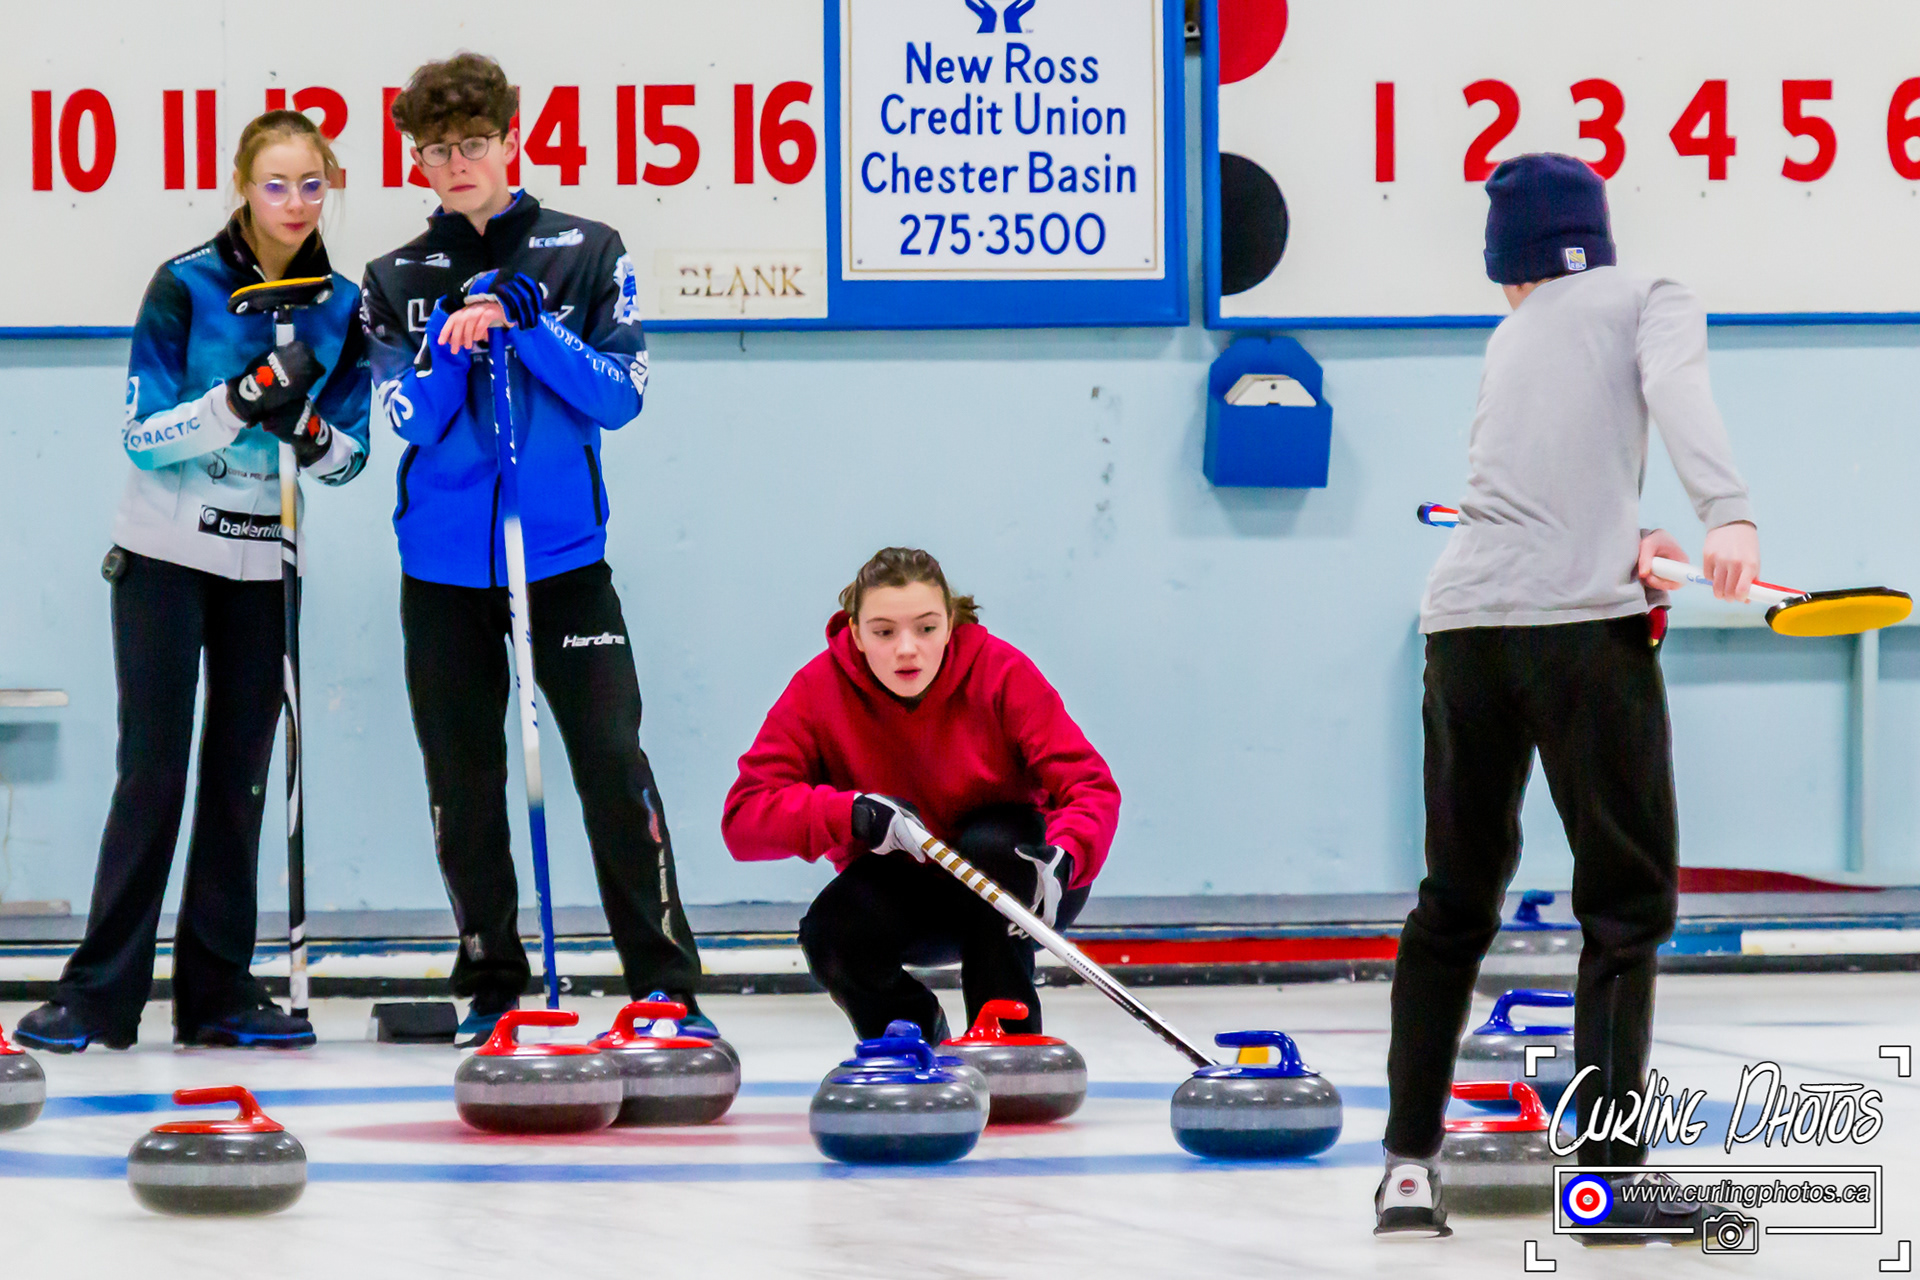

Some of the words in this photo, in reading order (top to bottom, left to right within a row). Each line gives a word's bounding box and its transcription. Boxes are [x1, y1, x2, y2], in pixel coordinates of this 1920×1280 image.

[906, 41, 993, 85] New
[1006, 42, 1099, 85] Ross
[881, 93, 1004, 136] Credit
[1015, 92, 1127, 136] Union
[1376, 82, 1395, 183] 1
[1463, 79, 1521, 182] 2
[1570, 78, 1627, 181] 3
[1669, 79, 1737, 181] 4
[1782, 79, 1838, 183] 5
[31, 88, 117, 194] 10
[163, 89, 218, 191] 11
[265, 86, 349, 190] 2
[382, 87, 433, 188] 1
[616, 84, 701, 187] 15
[734, 81, 818, 185] 16
[861, 152, 1020, 195] Chester
[1029, 151, 1137, 195] Basin
[679, 264, 805, 297] BLANK
[562, 631, 625, 648] Hardline
